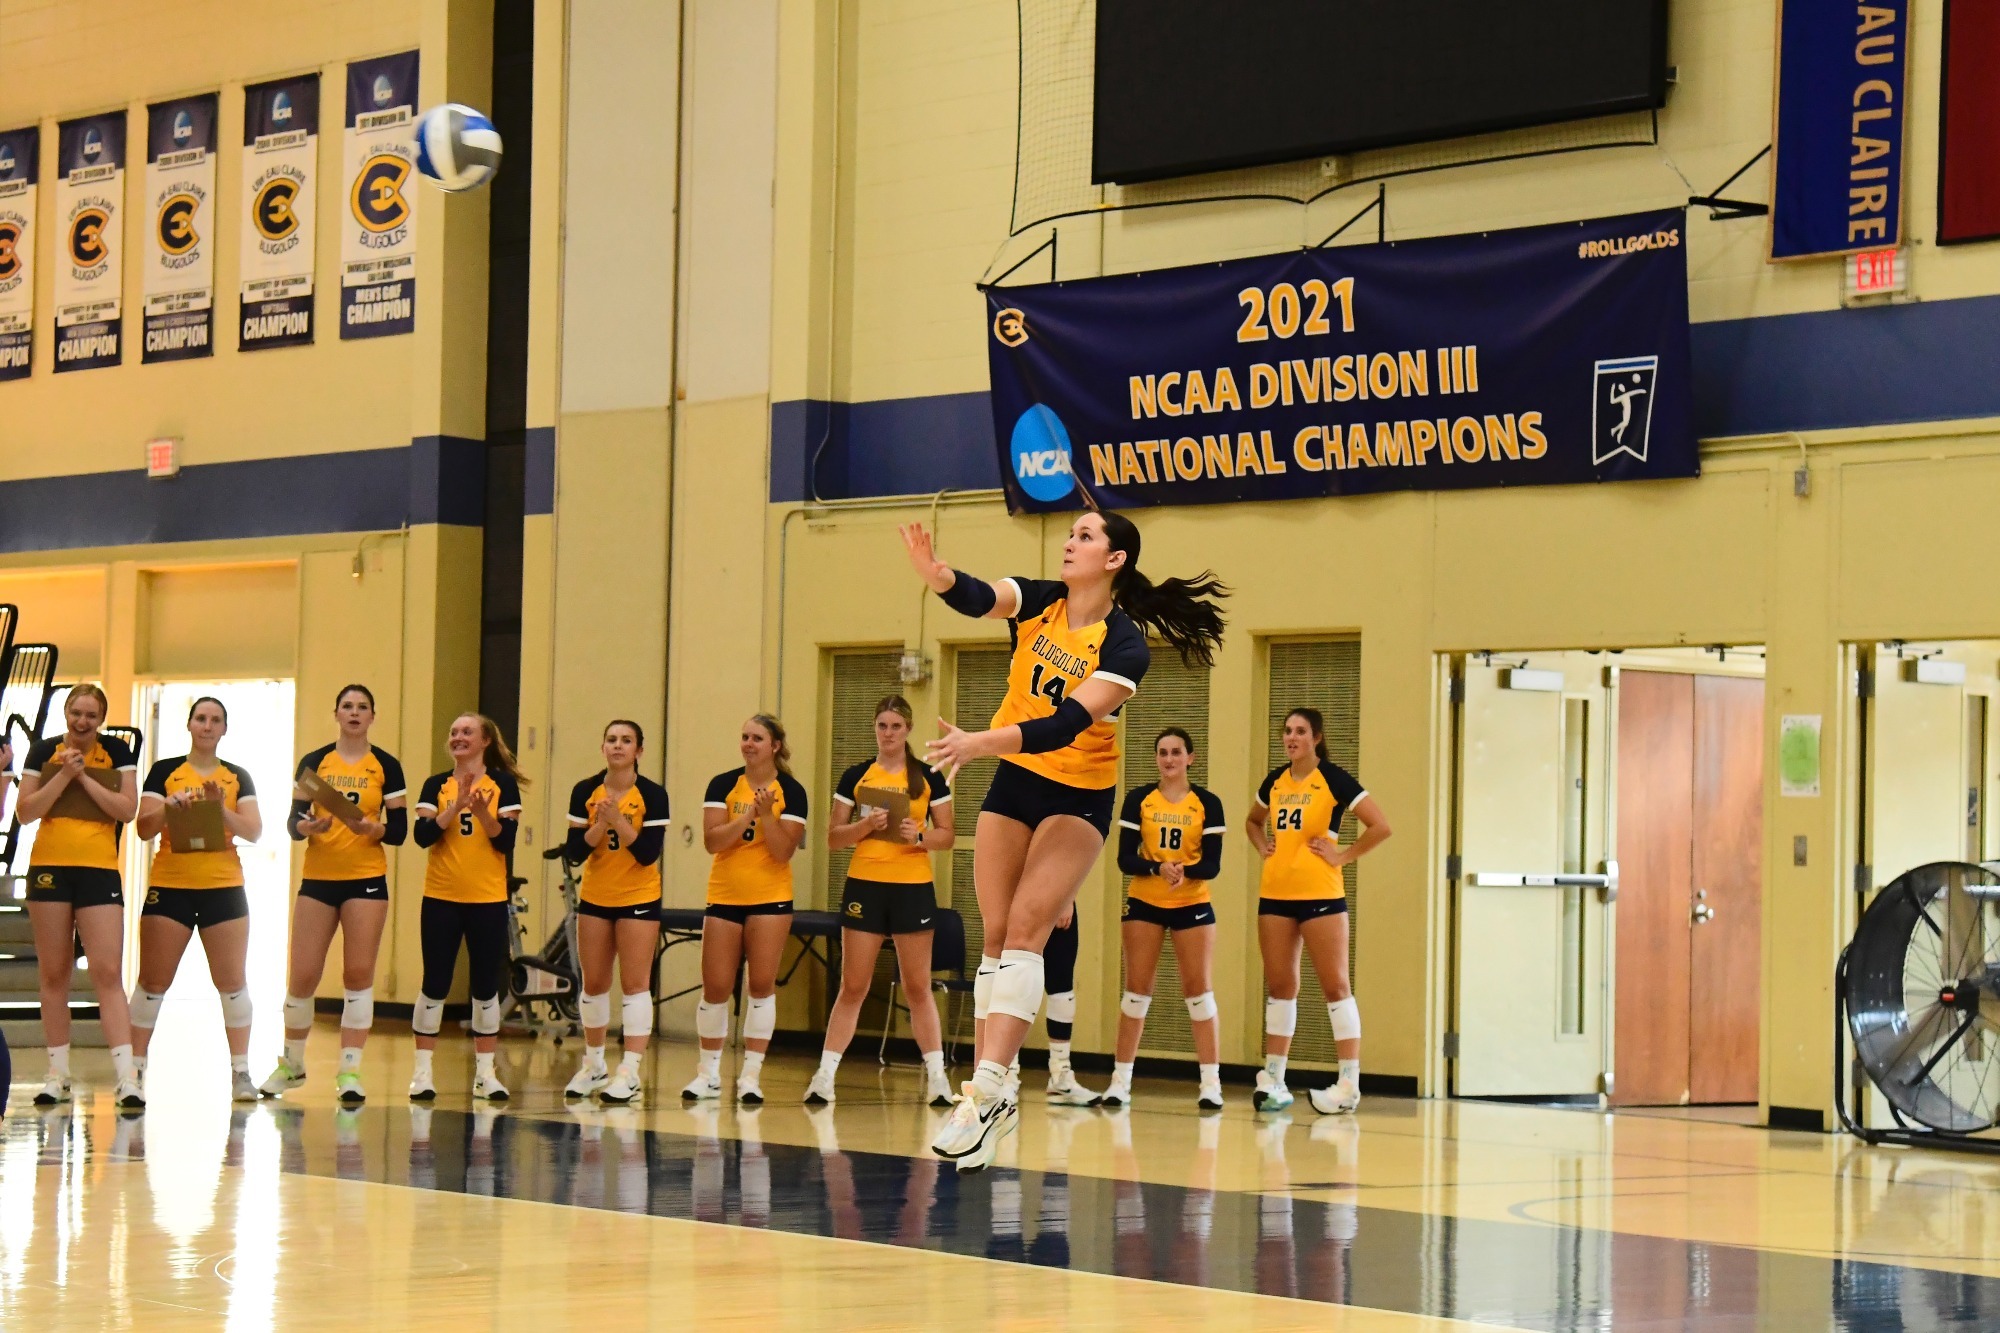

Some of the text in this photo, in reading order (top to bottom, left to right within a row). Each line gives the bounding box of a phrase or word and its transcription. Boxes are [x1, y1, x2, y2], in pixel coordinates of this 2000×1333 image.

[1848, 0, 1896, 243] AU CLAIRE
[360, 225, 407, 249] BLUGOLDS
[1578, 229, 1680, 259] #ROLLGOLDS
[1856, 250, 1897, 291] EXIT
[346, 297, 411, 325] CHAMPION
[1237, 276, 1355, 343] 2021
[146, 323, 208, 353] CHAMPION
[243, 310, 309, 340] CHAMPION
[58, 333, 117, 362] CHAMPION
[1129, 345, 1479, 420] NCAA DIVISION III
[1089, 411, 1548, 487] NATIONAL CHAMPIONS
[1031, 634, 1088, 679] BLUGOLDS
[1031, 663, 1067, 707] 14
[460, 812, 473, 836] 5
[1276, 808, 1303, 831] 24
[607, 828, 620, 851] 3
[1160, 826, 1182, 850] 18
